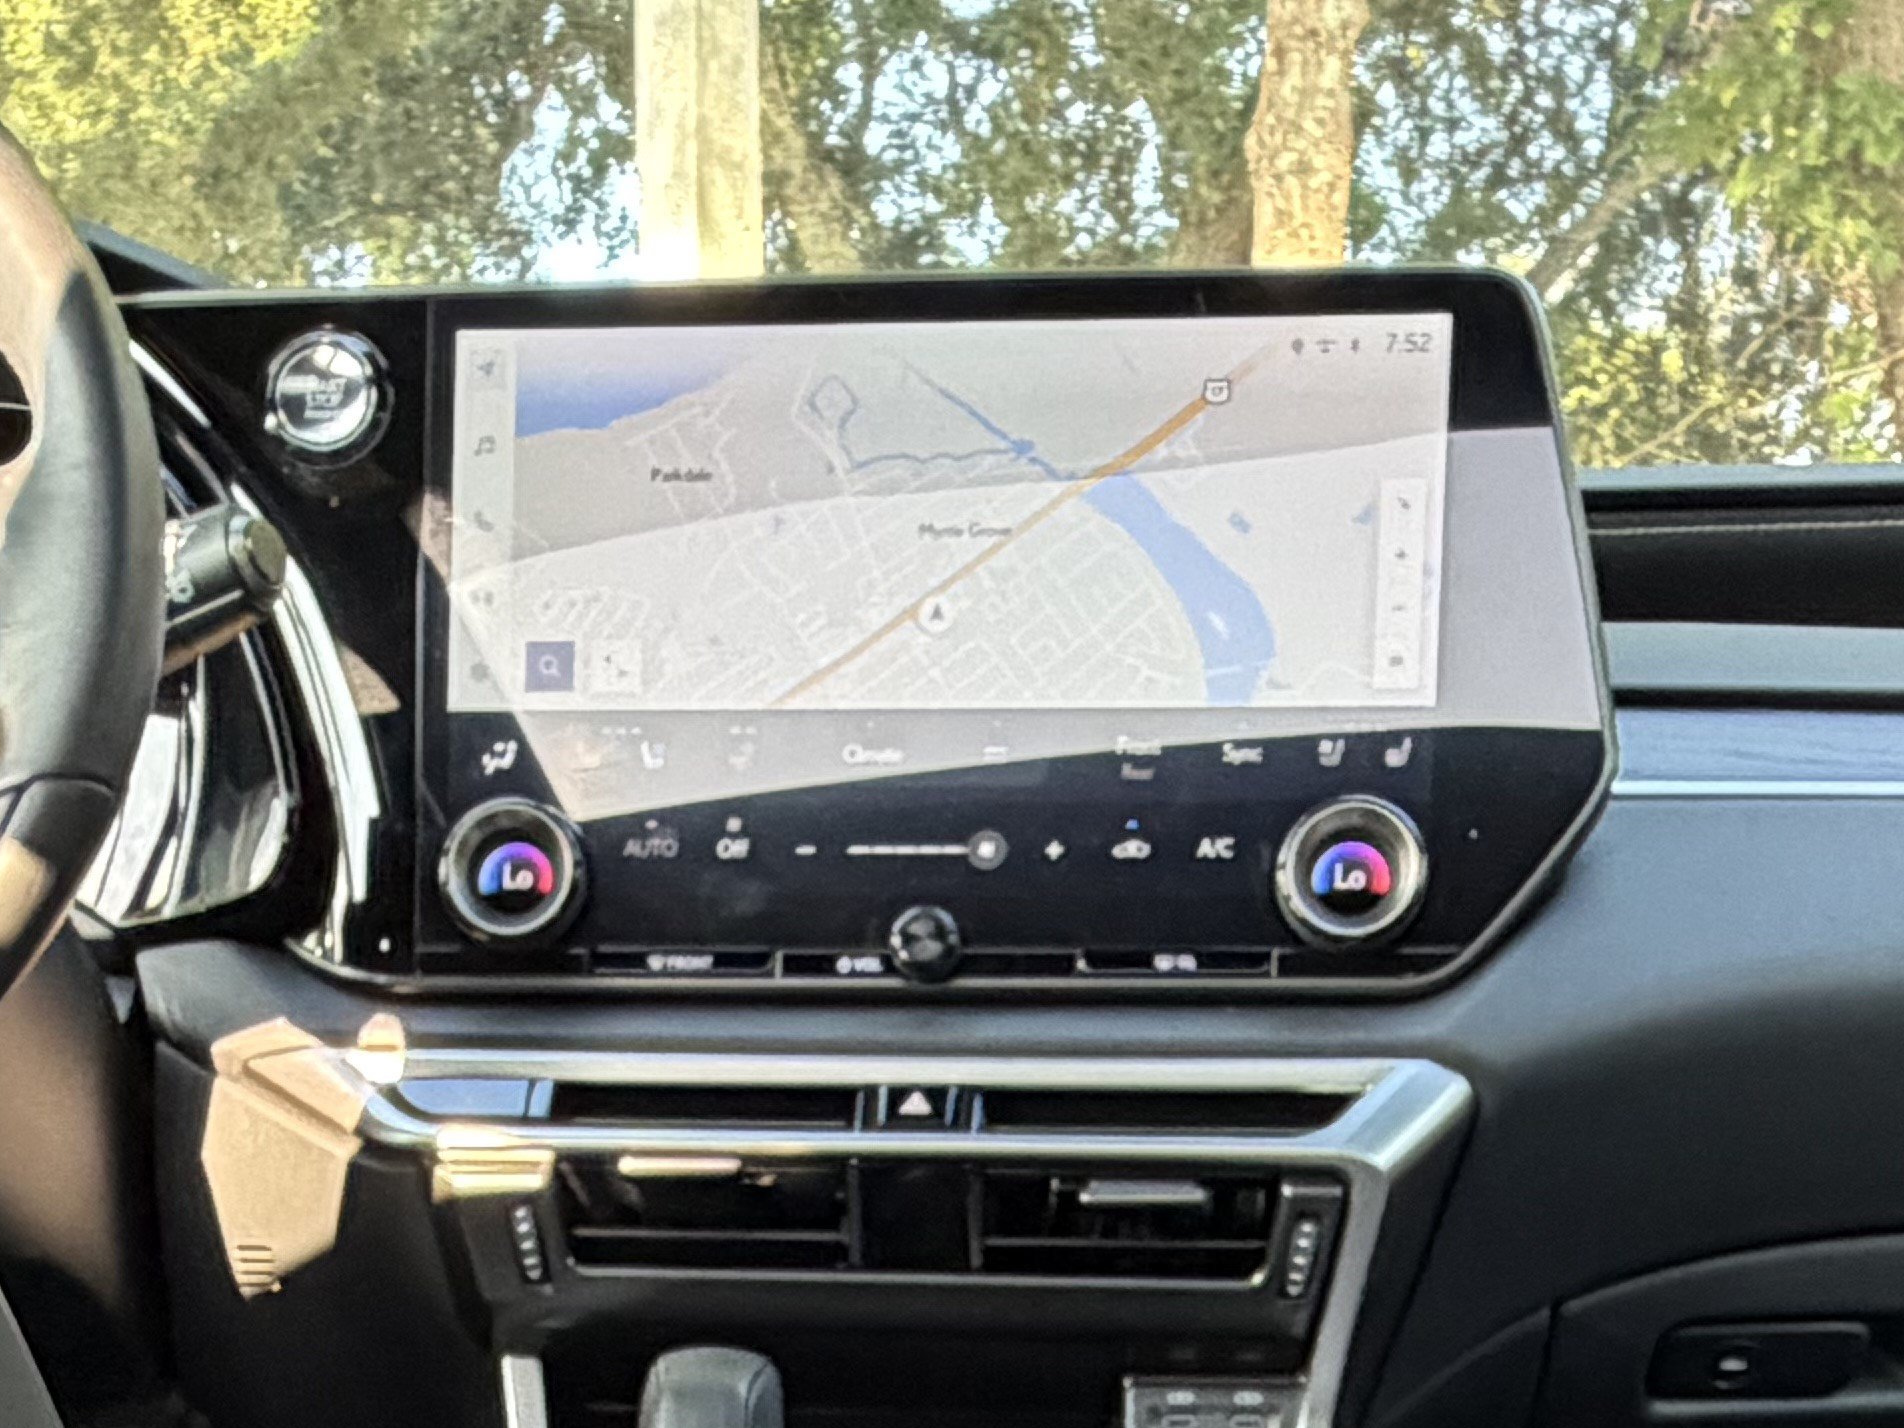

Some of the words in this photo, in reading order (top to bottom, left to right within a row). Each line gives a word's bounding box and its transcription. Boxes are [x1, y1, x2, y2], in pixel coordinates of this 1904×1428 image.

[623, 837, 679, 859] AUTO
[502, 862, 534, 890] Lo
[1334, 863, 1367, 891] Lo
